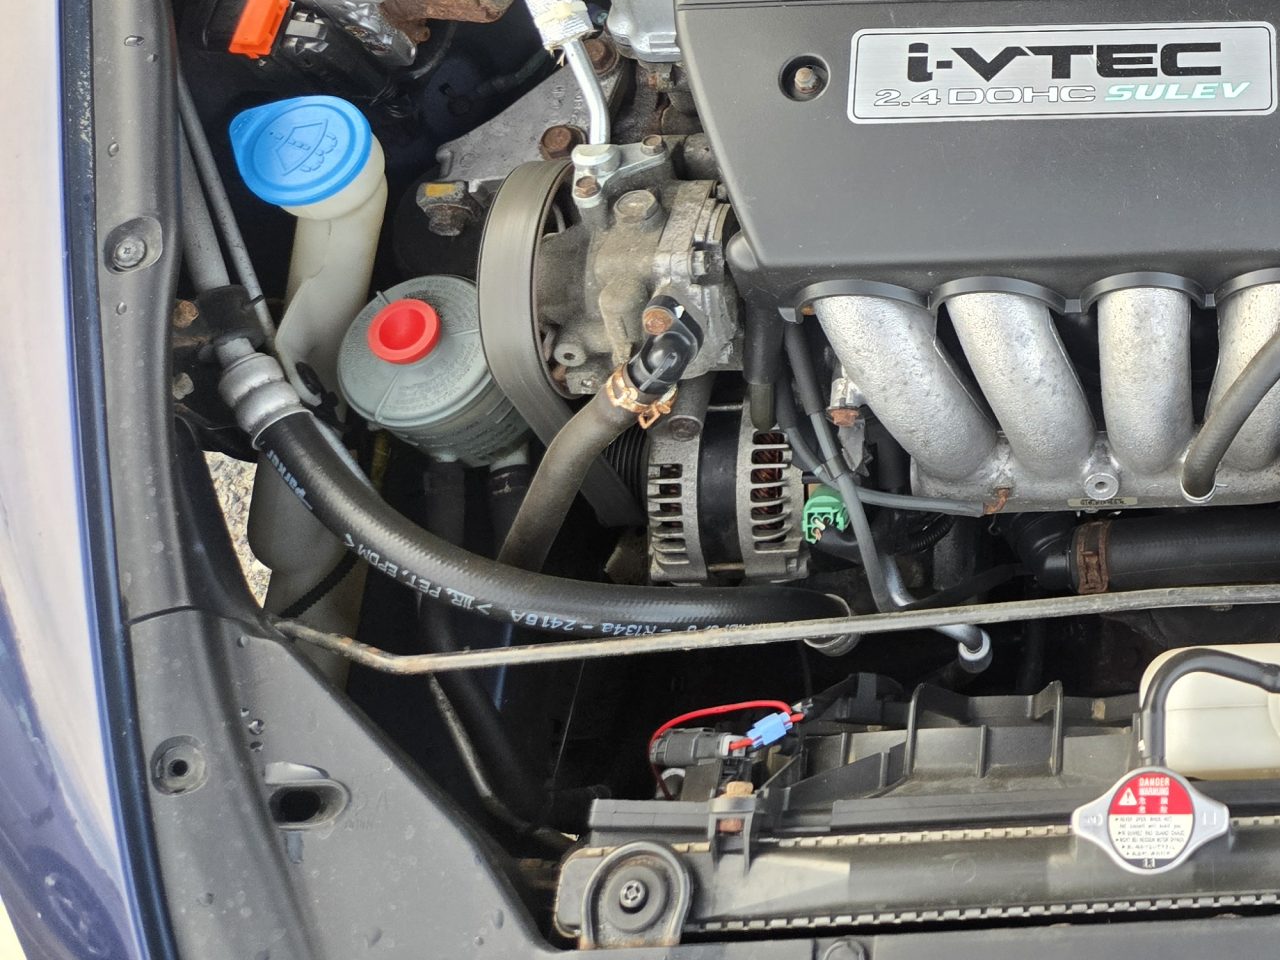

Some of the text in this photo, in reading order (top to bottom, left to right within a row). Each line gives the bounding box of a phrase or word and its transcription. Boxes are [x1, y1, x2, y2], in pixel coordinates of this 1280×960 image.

[907, 42, 1222, 83] i-VTEC
[873, 81, 1252, 107] 2.4 DOHC SULEV
[1139, 777, 1170, 786] DANGER
